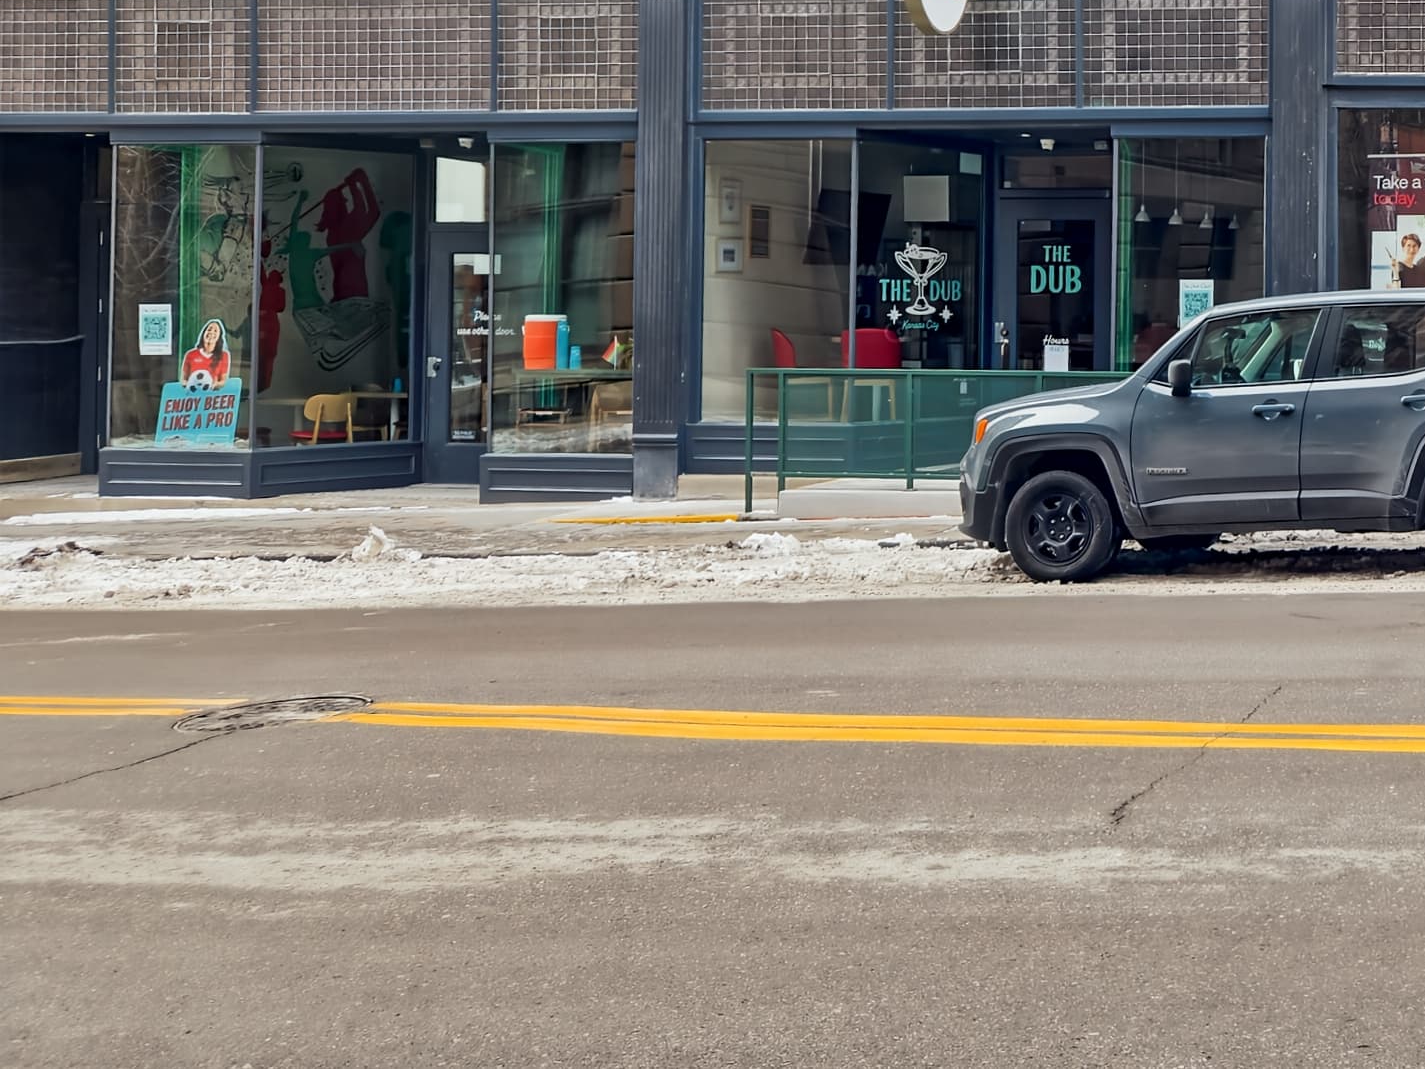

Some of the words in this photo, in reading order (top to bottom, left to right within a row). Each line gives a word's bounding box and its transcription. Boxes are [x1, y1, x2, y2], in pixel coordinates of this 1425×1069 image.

[1373, 175, 1409, 190] Take
[1412, 178, 1422, 189] a
[1373, 191, 1417, 208] today.
[1042, 245, 1072, 263] THE
[1030, 265, 1082, 294] DUB
[879, 279, 912, 302] THE
[929, 279, 962, 302] DUB
[901, 319, 925, 331] Kansas
[925, 319, 940, 331] City
[1042, 334, 1070, 346] Hours
[164, 397, 201, 414] ENJOY
[203, 395, 236, 411] BEER
[162, 414, 190, 431] LIKE
[193, 415, 203, 429] A
[205, 411, 234, 429] PRO
